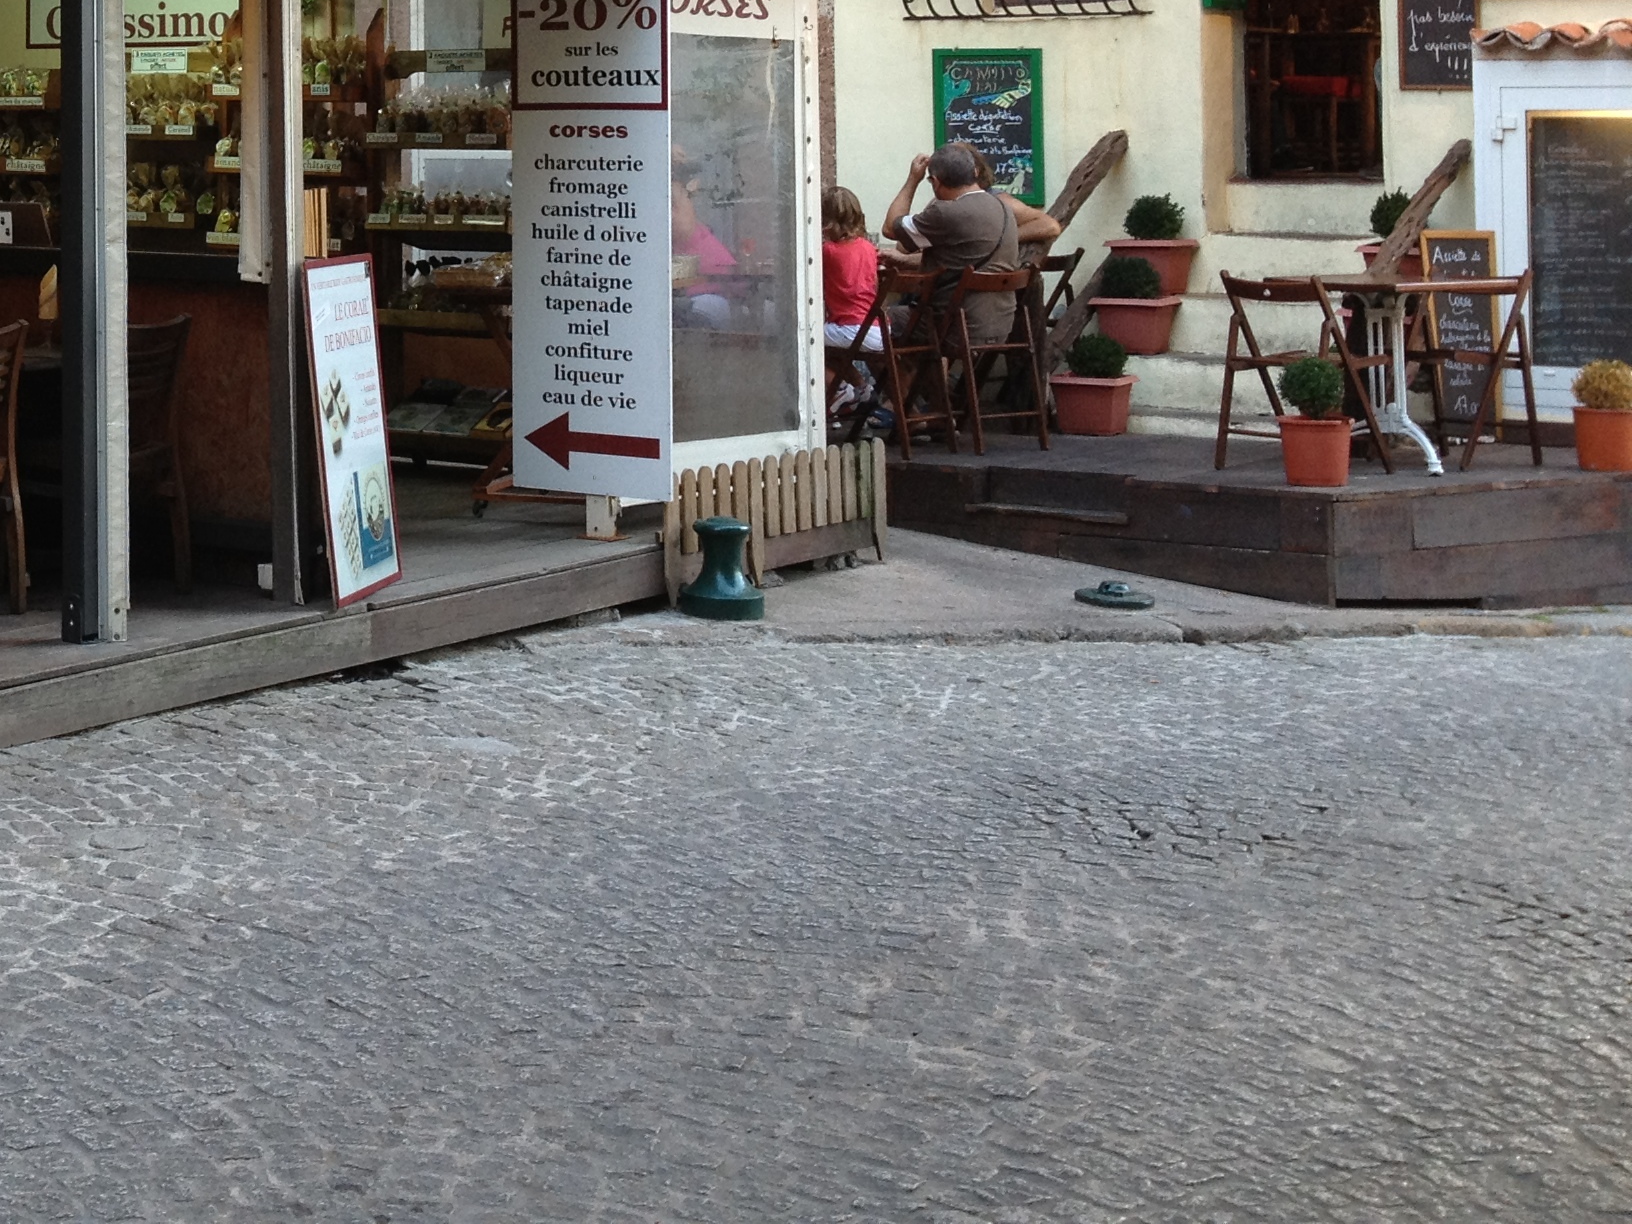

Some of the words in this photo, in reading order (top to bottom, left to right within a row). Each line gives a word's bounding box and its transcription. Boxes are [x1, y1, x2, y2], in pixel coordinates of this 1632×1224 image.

[1407, 9, 1433, 37] pas
[565, 44, 592, 58] sur
[595, 40, 619, 57] les
[530, 64, 660, 89] couteaux
[549, 122, 629, 140] corses
[534, 153, 644, 173] charcuterie
[548, 177, 629, 198] fromage
[540, 200, 636, 220] canistrelli
[530, 223, 579, 244] huile
[582, 225, 596, 243] d
[599, 225, 648, 245] olive
[546, 246, 604, 266] farine
[607, 249, 632, 267] de
[540, 270, 634, 294] châtaigne
[544, 295, 634, 320] tapenade
[567, 317, 610, 337] miel
[544, 340, 634, 362] confiture
[553, 363, 625, 387] liqueur
[542, 392, 580, 407] eau
[583, 389, 606, 409] de
[608, 391, 637, 411] vie
